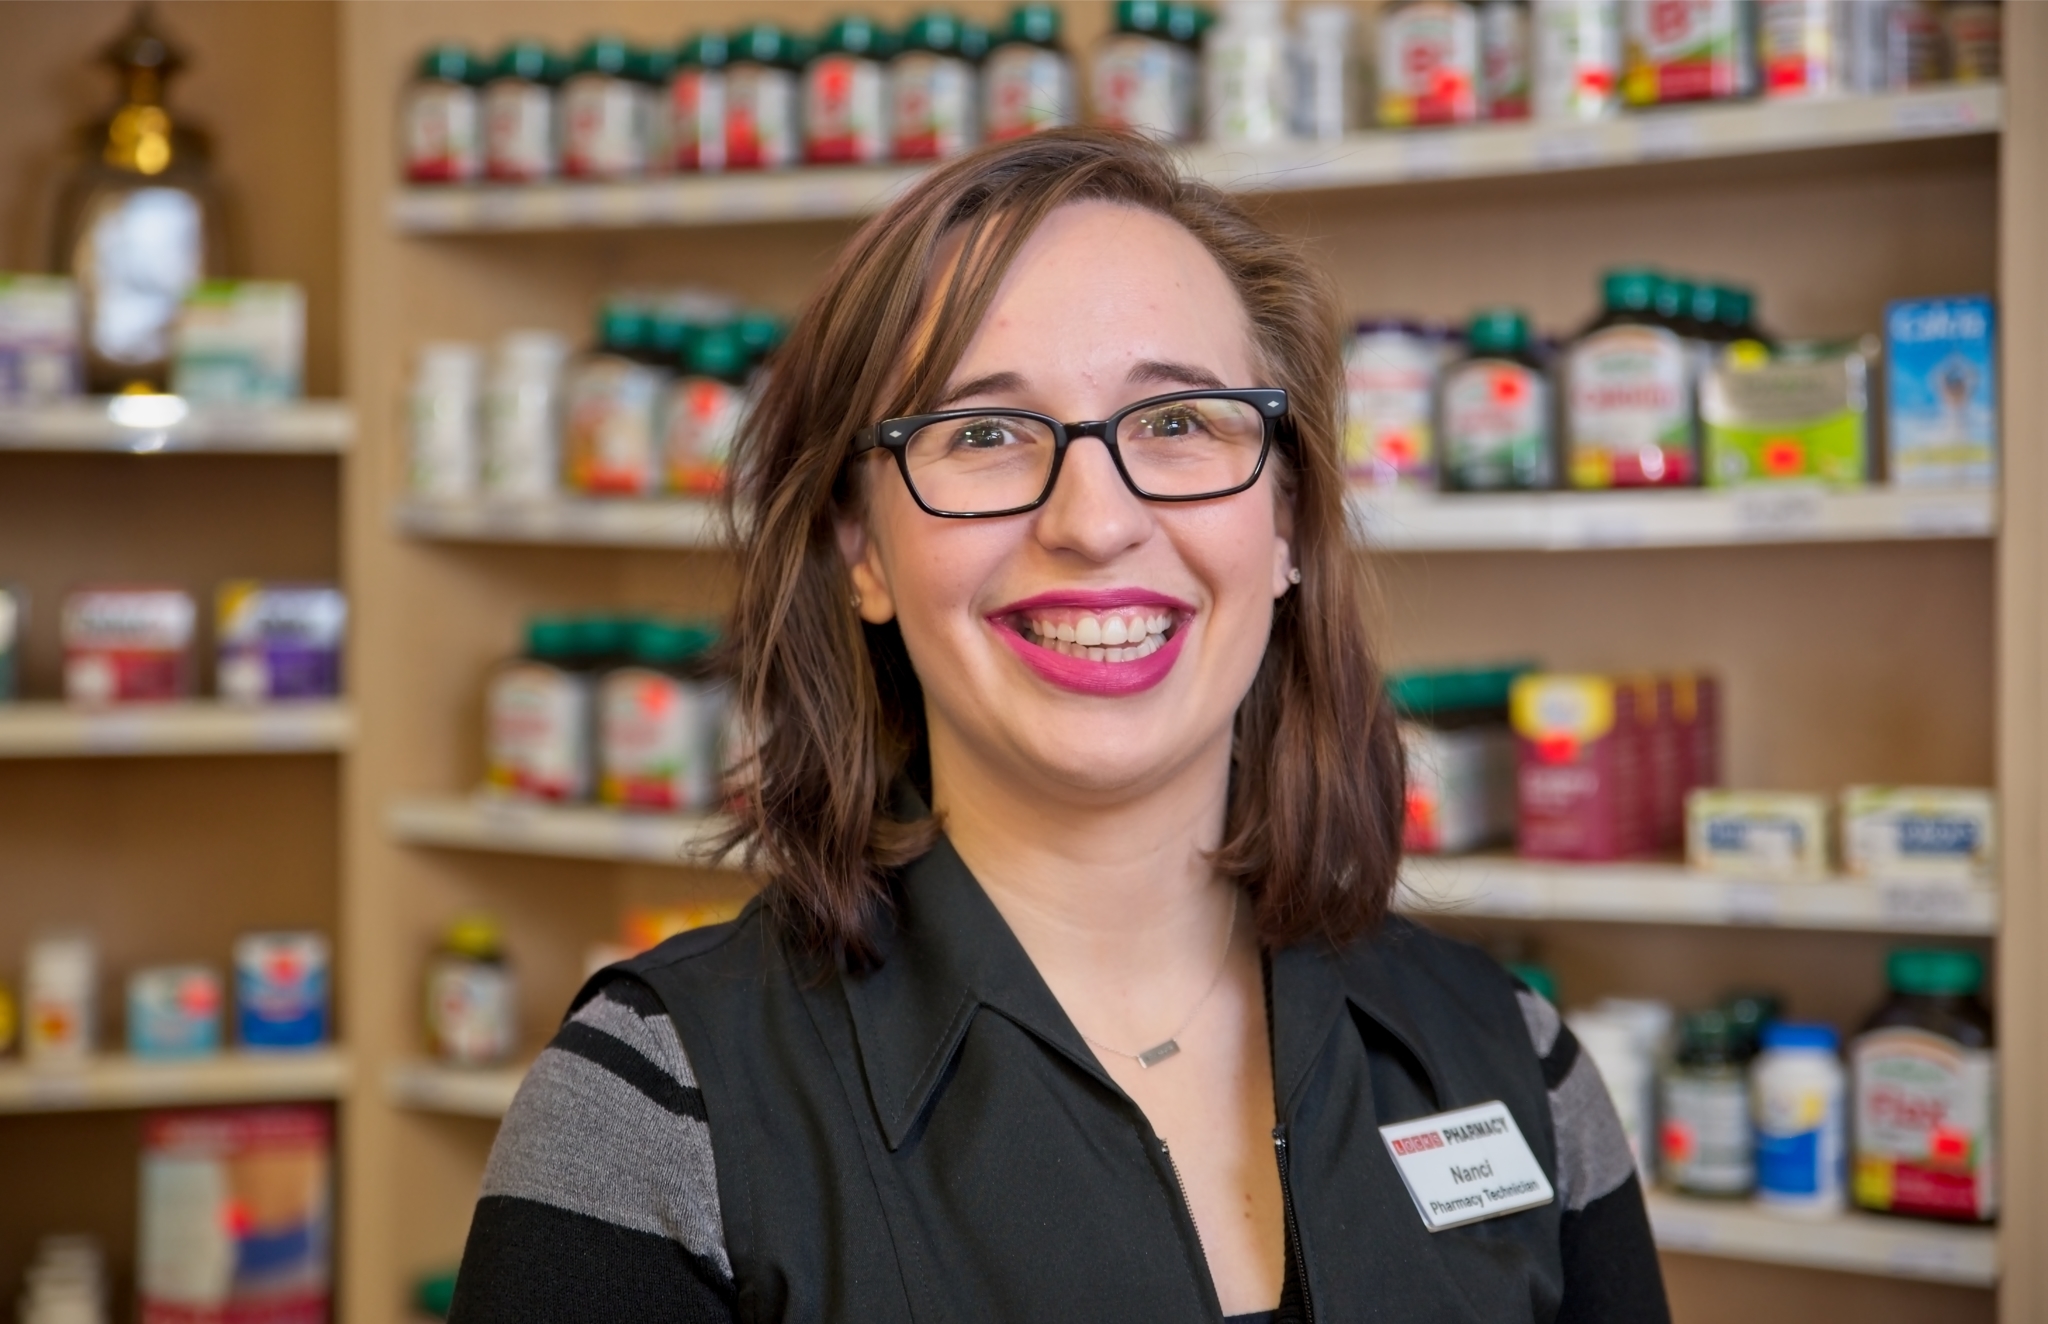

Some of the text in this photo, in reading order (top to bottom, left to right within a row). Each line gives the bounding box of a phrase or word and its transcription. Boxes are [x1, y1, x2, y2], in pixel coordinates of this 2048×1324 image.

[1393, 1117, 1508, 1155] LOCKS PHARMACY
[1450, 1160, 1494, 1185] Nanci
[1430, 1179, 1541, 1215] Pharmacy Technician
